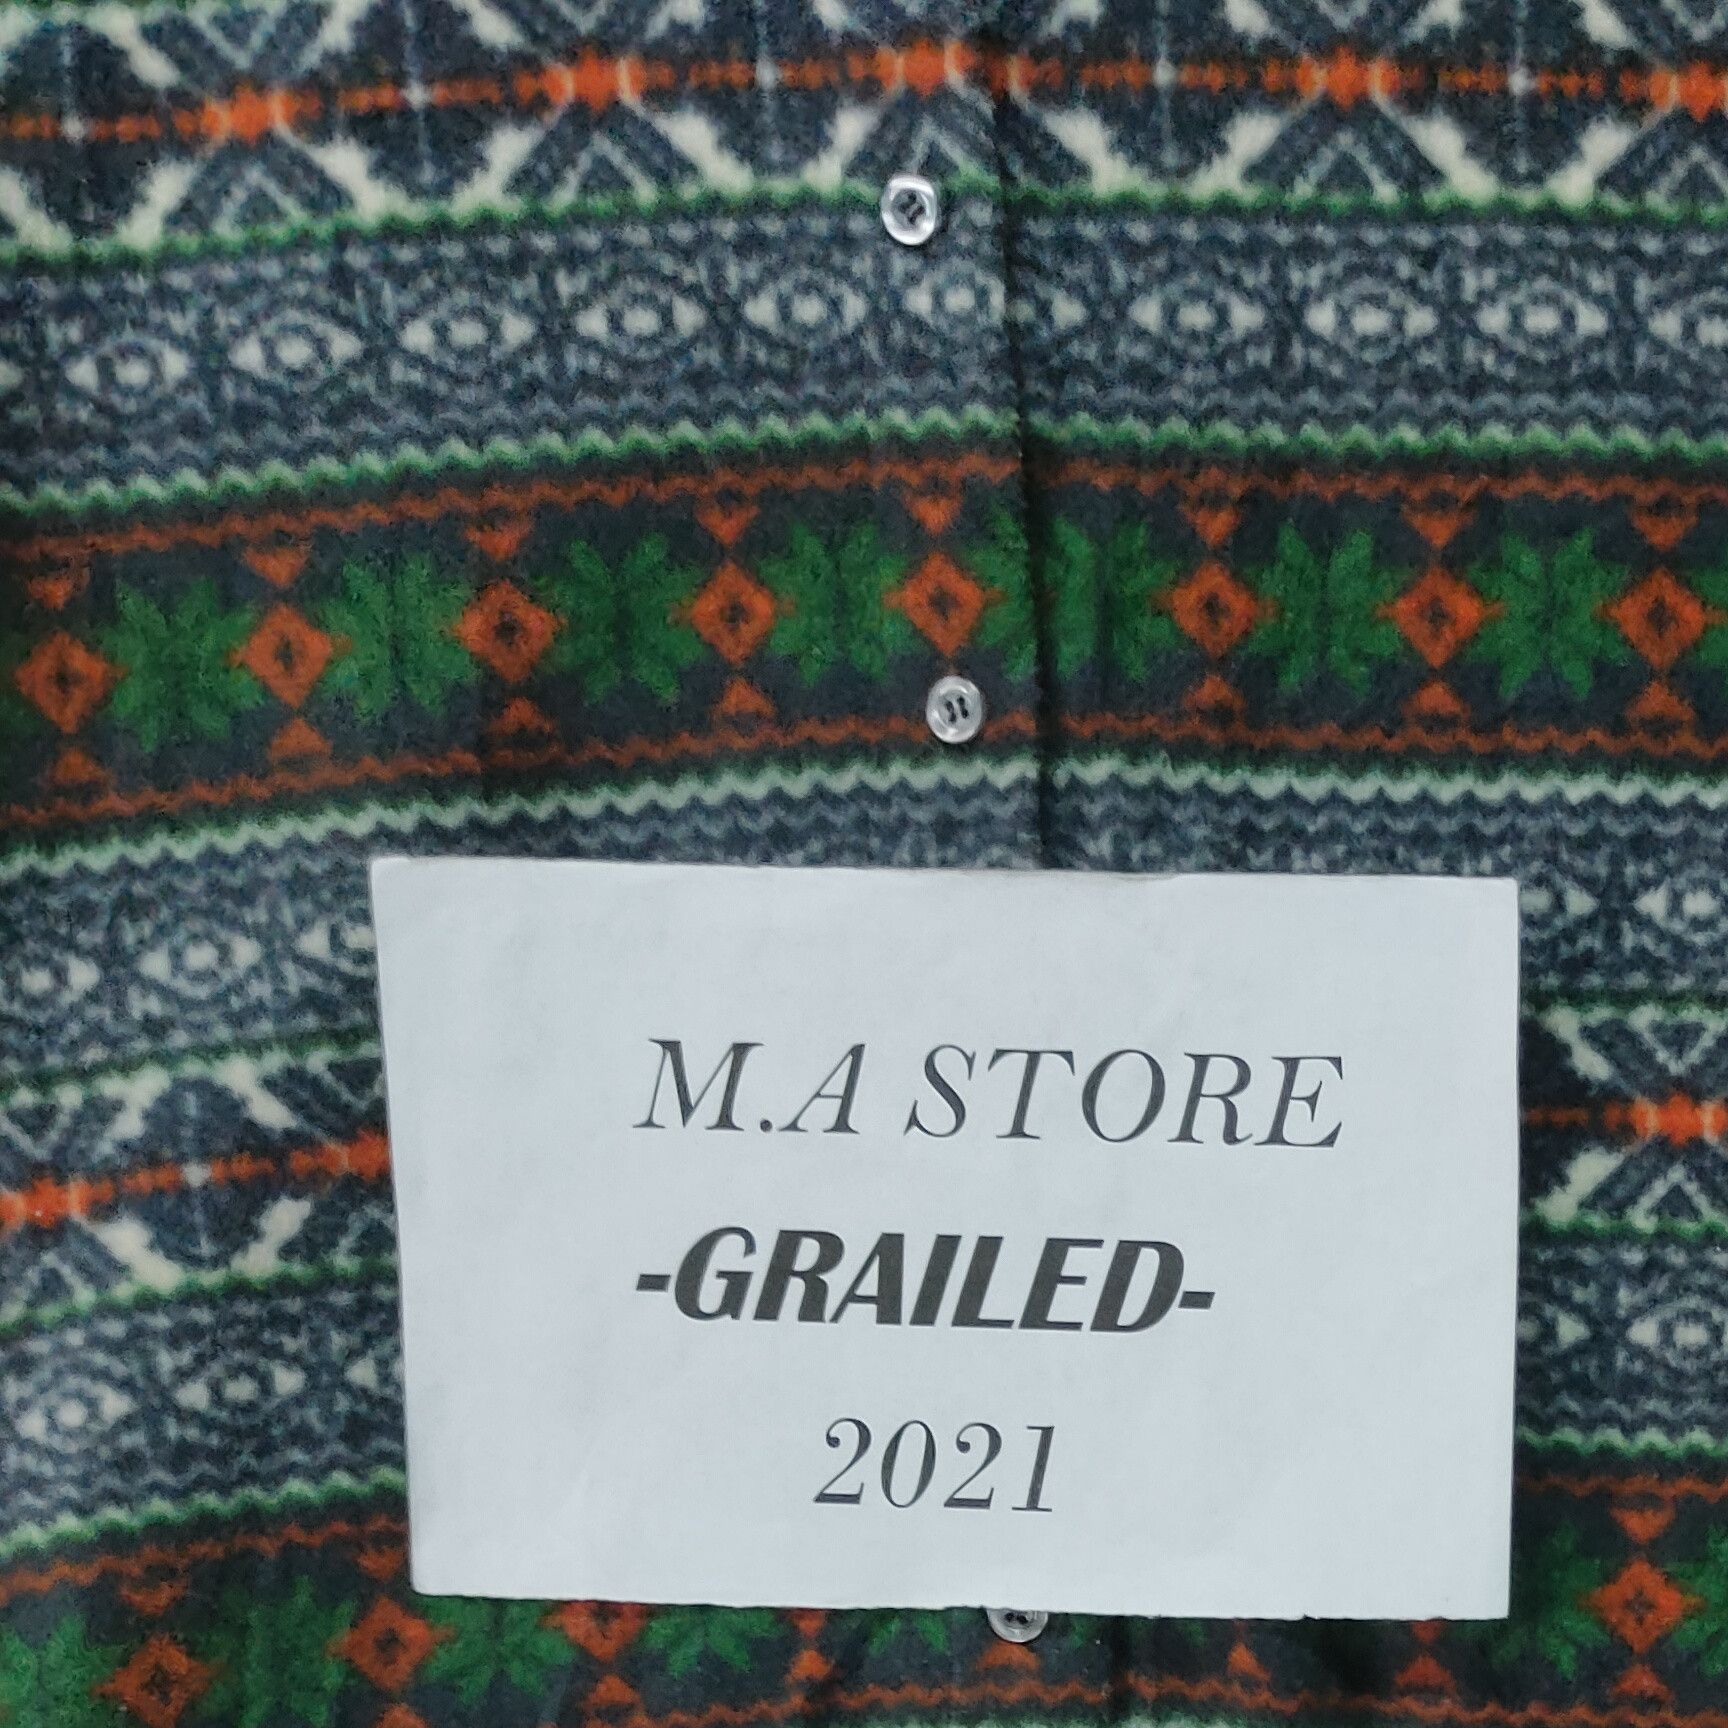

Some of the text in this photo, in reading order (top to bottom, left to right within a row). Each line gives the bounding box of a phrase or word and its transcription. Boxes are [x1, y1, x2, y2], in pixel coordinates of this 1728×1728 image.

[634, 1037, 1344, 1148] M.A STORE
[635, 1226, 1216, 1333] -GRAILED-
[813, 1417, 1056, 1512] 2021
